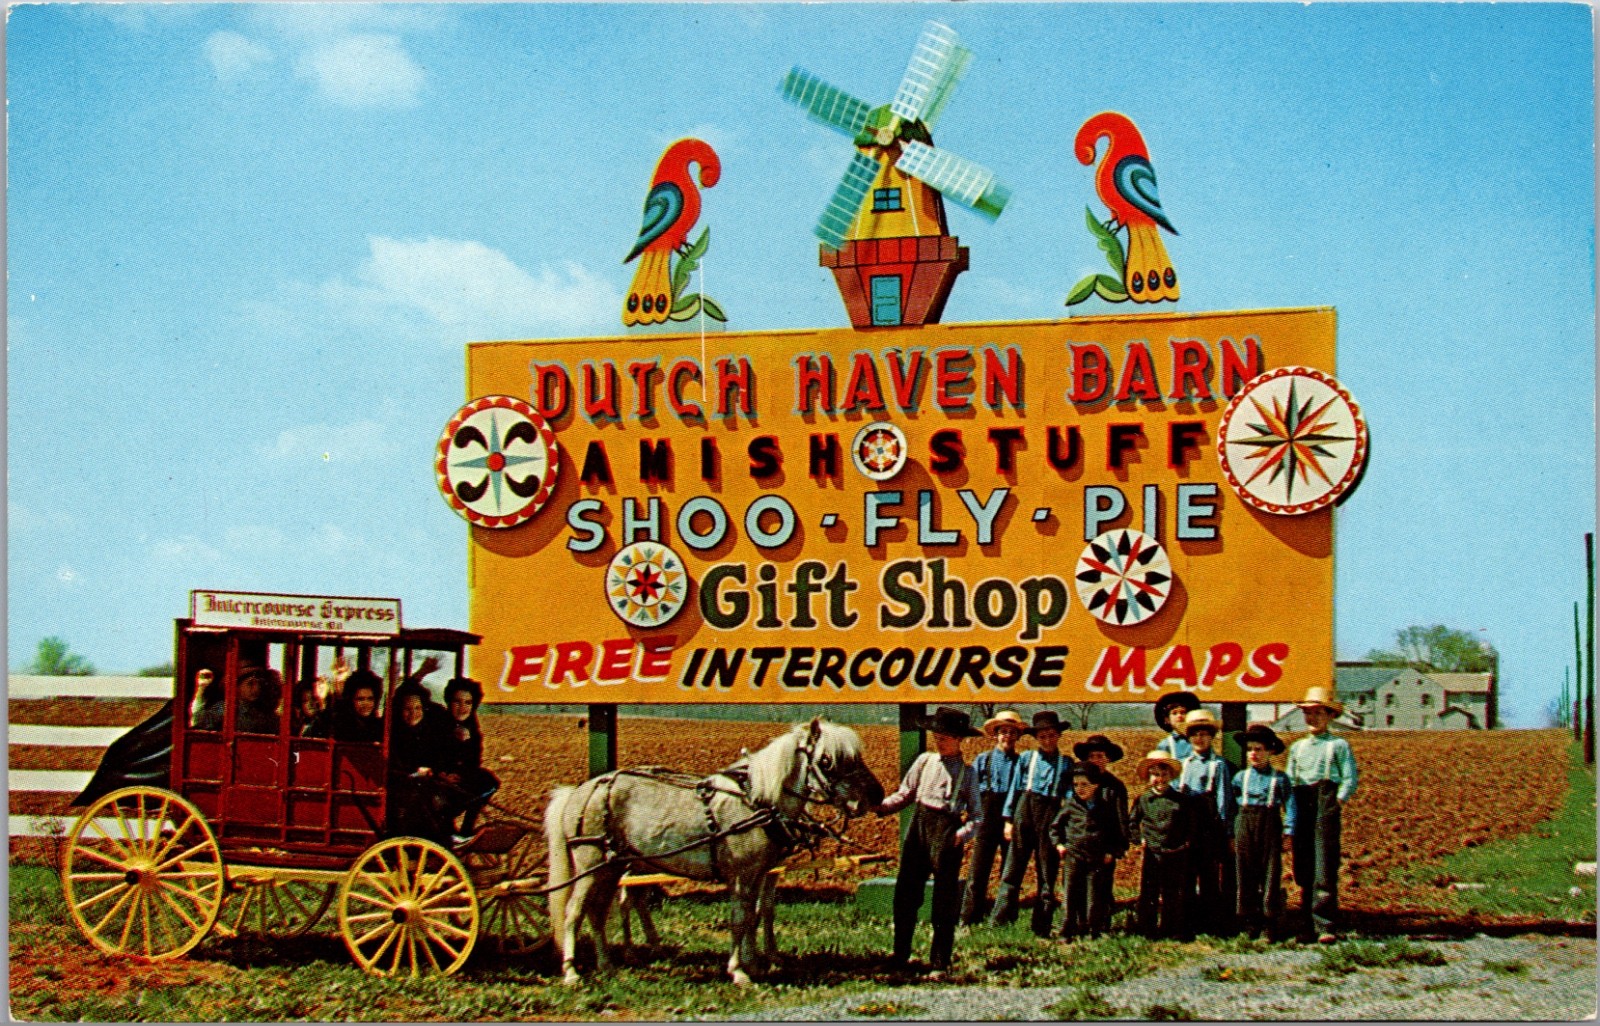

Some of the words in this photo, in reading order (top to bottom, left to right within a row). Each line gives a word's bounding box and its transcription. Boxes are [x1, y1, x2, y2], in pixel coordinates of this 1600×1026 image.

[530, 354, 757, 422] DUTCH
[792, 343, 1025, 416] HAVEN
[1066, 334, 1263, 406] BARN
[580, 432, 840, 486] AMISH
[928, 420, 1207, 475] STUFF
[203, 594, 315, 618] Intercourse
[320, 600, 396, 622] Express
[699, 560, 860, 631] Gift
[878, 555, 1070, 643] Shop
[500, 634, 679, 693] FREE
[678, 644, 1070, 693] INTERCOURSE
[1086, 641, 1290, 694] MAPS
